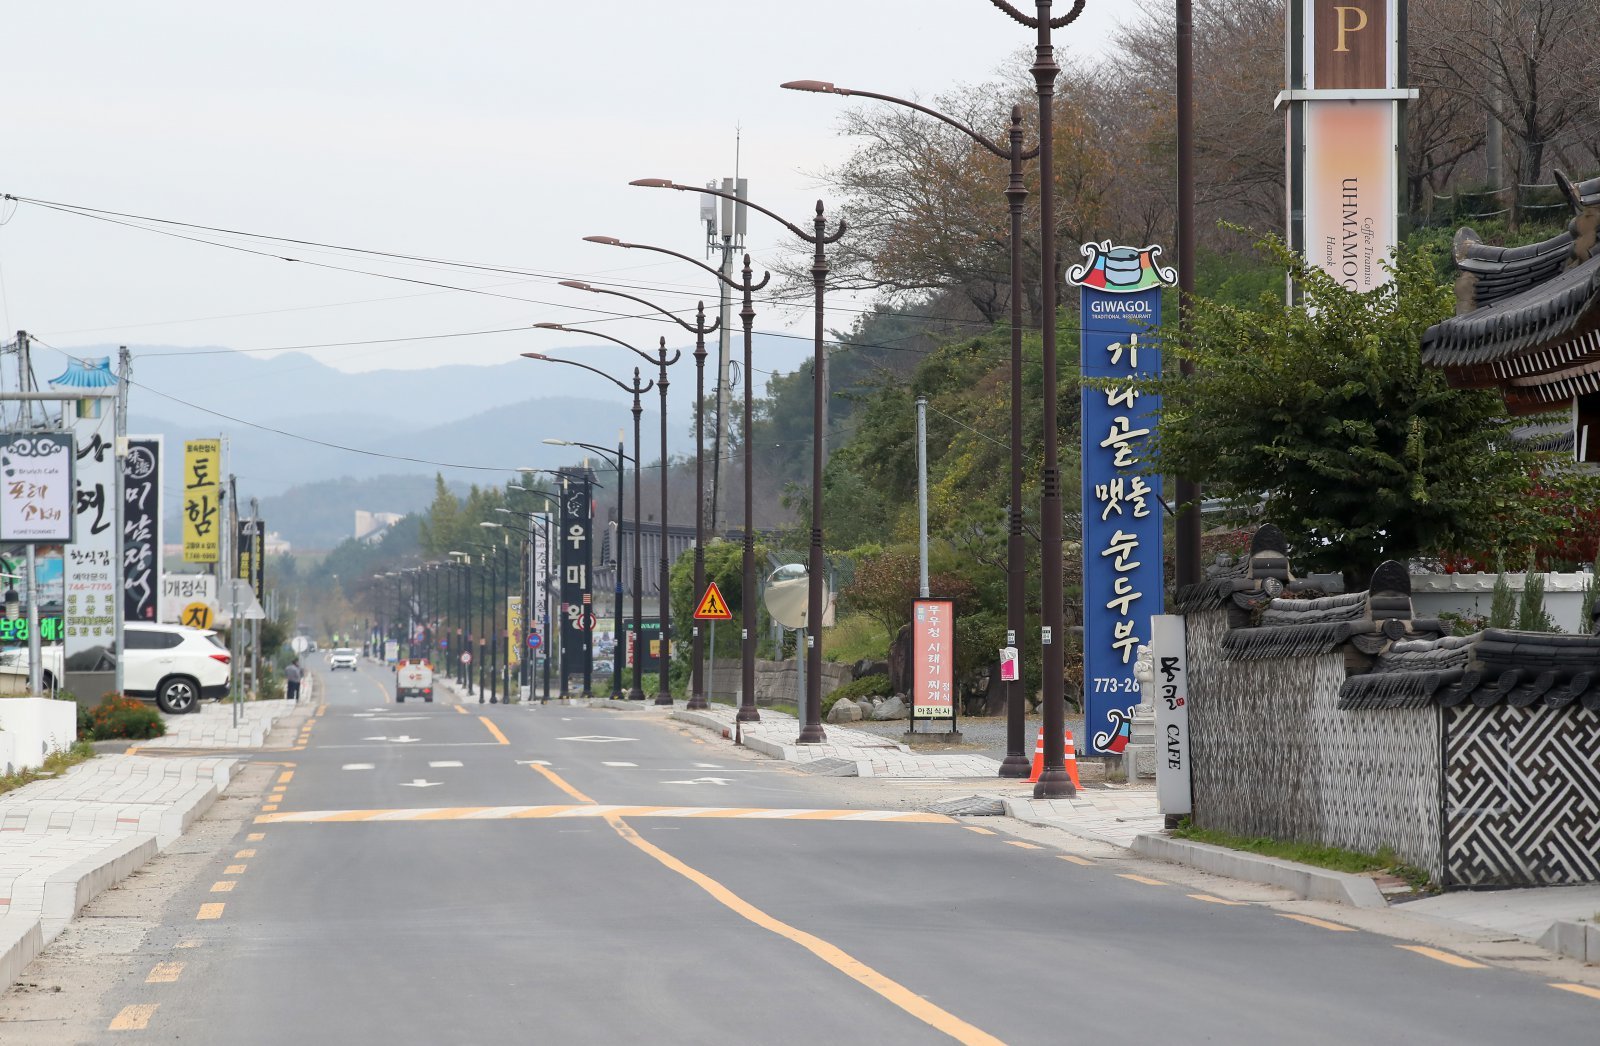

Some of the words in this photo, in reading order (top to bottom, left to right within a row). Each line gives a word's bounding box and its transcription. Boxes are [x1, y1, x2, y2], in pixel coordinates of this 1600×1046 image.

[1332, 6, 1368, 52] P
[1360, 217, 1375, 245] Coffee
[1326, 236, 1336, 267] Hanok
[1364, 246, 1374, 286] Tiramisu
[1091, 300, 1152, 313] GIWAGOL
[185, 458, 217, 537] 토함
[1095, 476, 1152, 521] 맷돌
[1101, 529, 1143, 664] 순두부
[928, 642, 941, 675] 시래기
[927, 681, 941, 701] 찌개
[1166, 723, 1182, 771] CAFE
